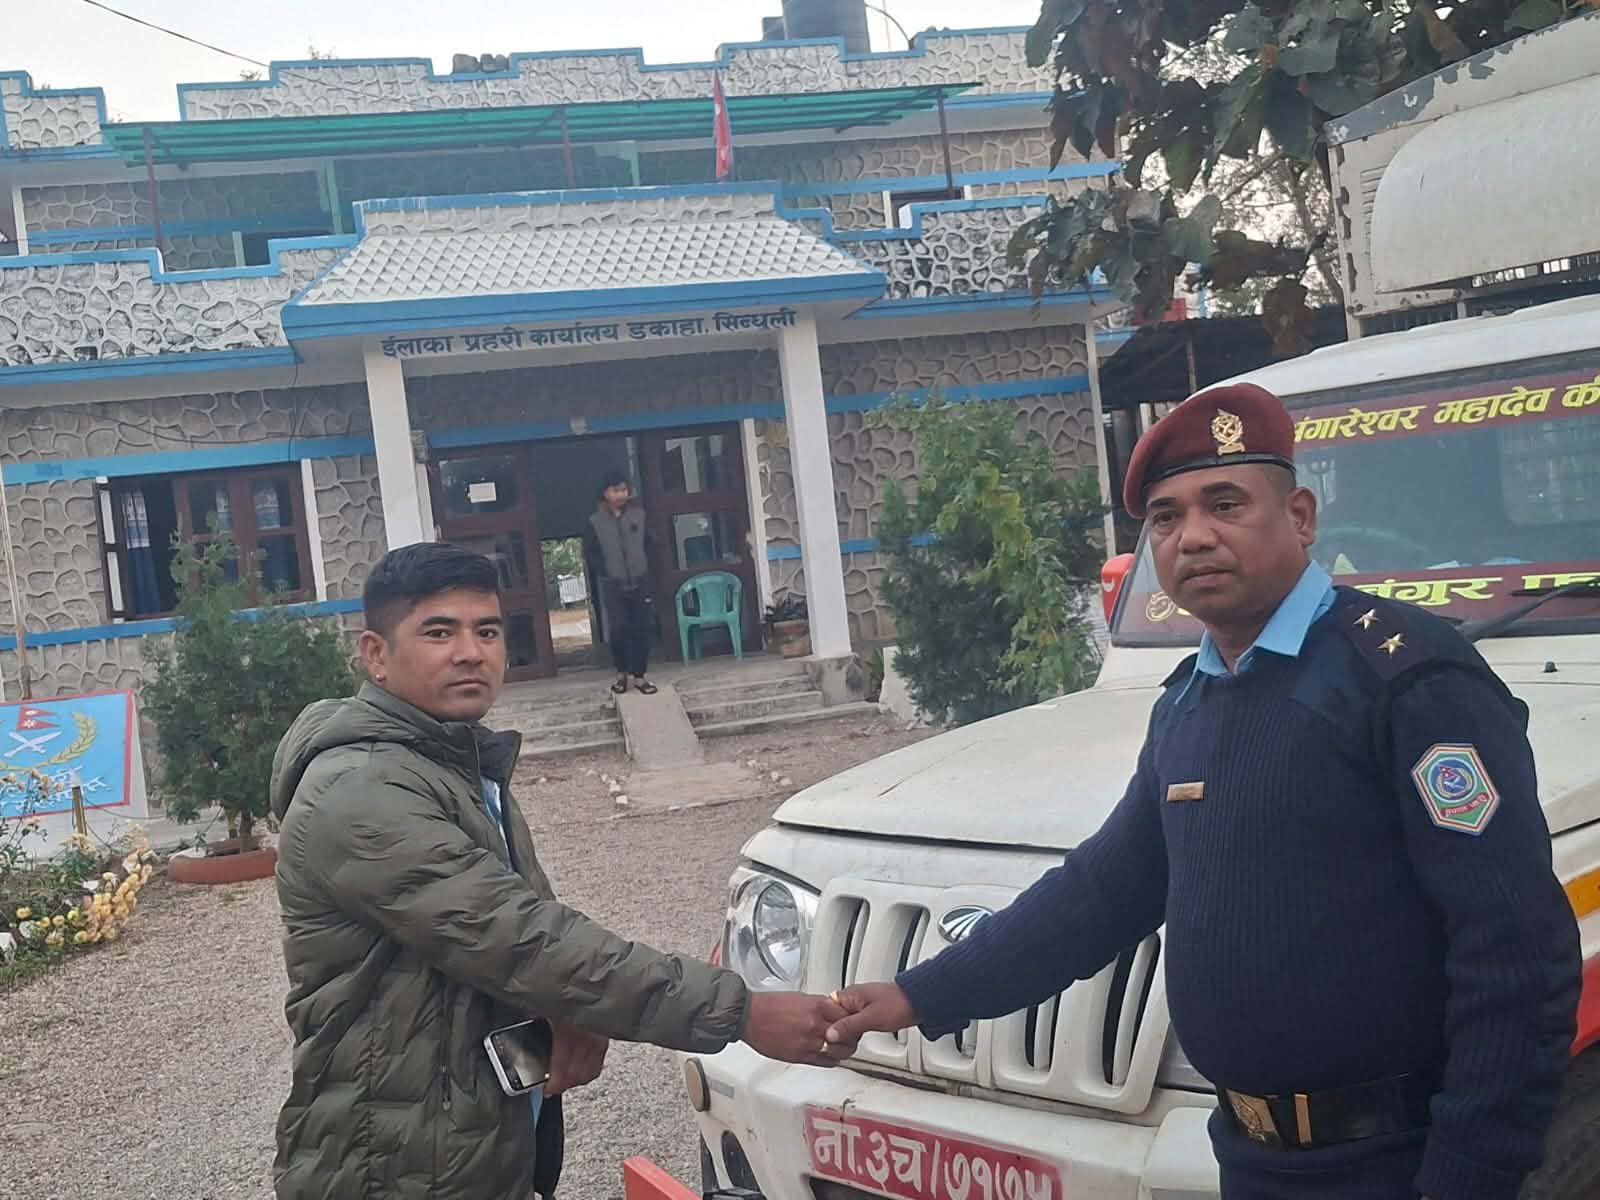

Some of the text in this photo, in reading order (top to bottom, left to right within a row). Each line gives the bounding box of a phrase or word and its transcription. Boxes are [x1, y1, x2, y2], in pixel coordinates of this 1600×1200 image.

[461, 325, 524, 352] प्रहरी
[528, 321, 619, 347] कार्यालय
[1433, 385, 1555, 424] महादेव
